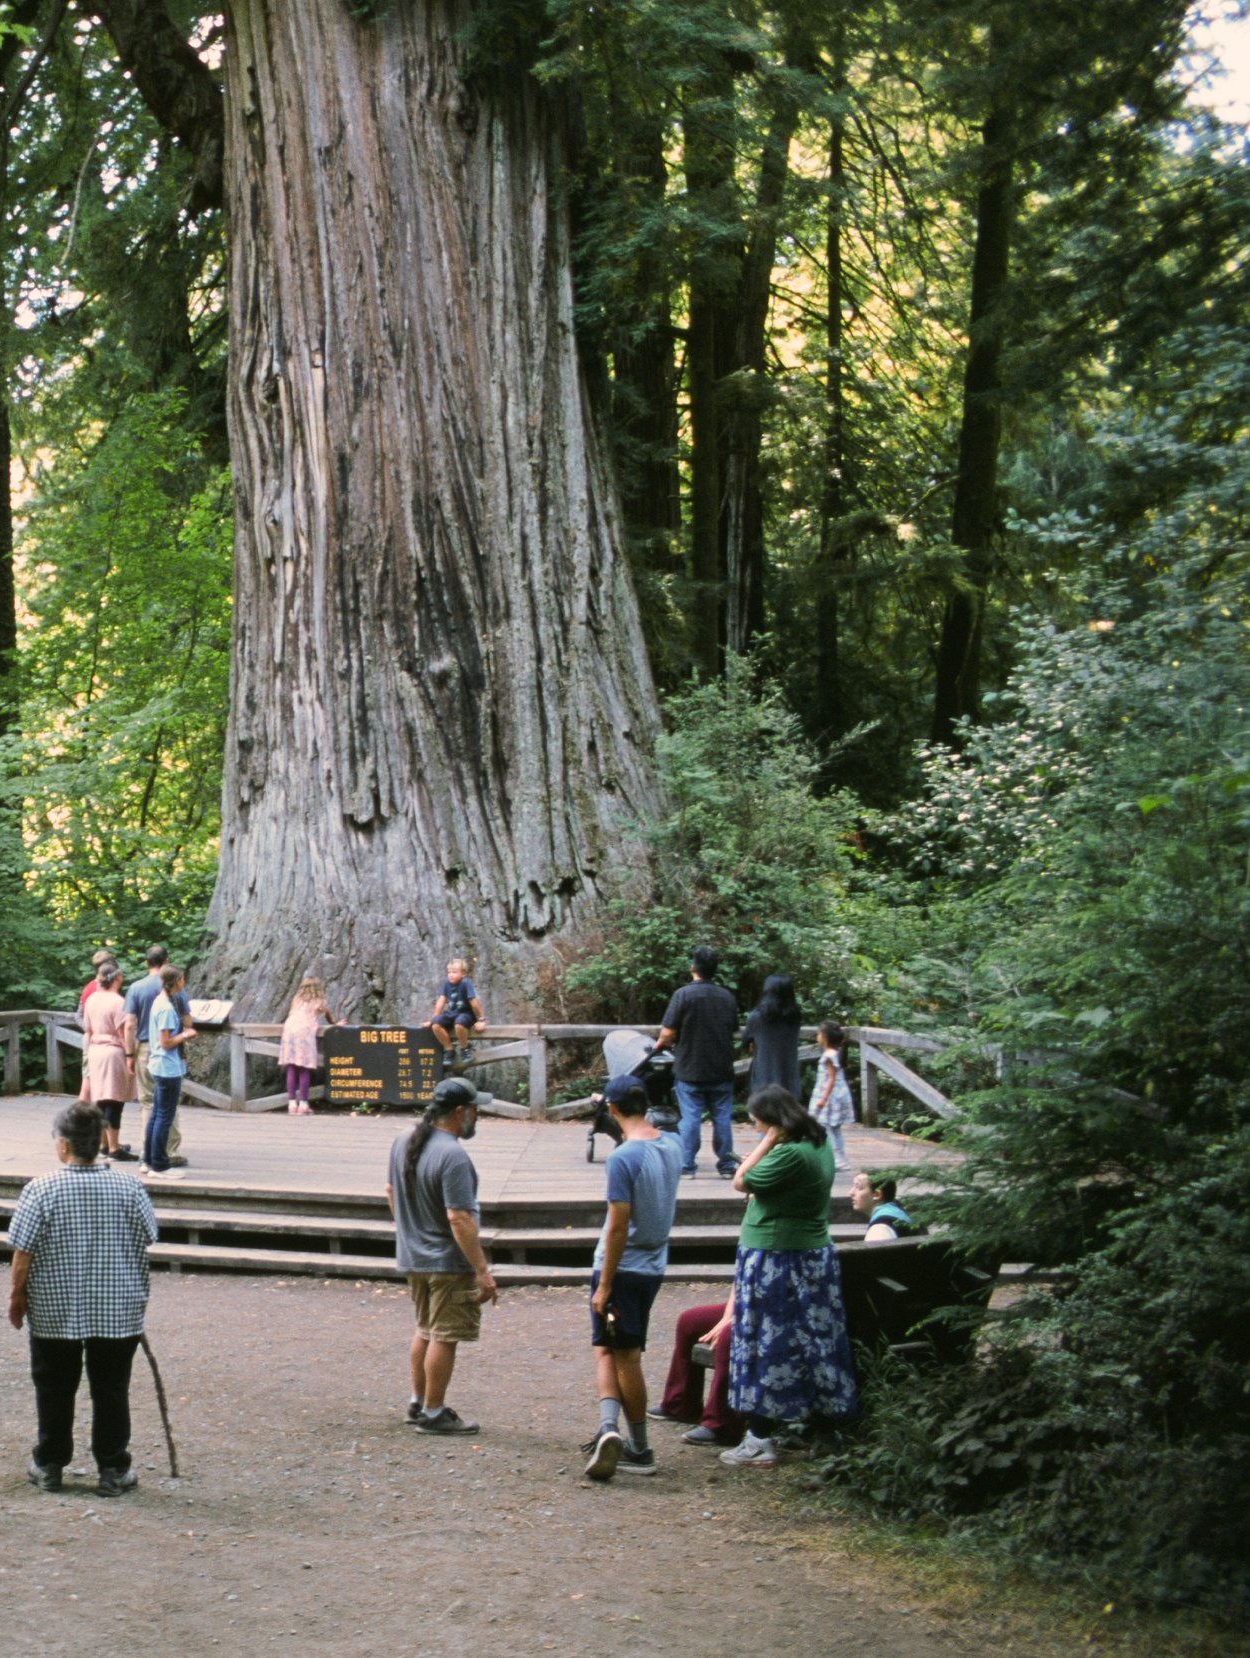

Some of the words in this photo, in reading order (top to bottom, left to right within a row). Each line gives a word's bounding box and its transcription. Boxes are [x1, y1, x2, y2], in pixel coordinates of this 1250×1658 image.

[360, 1030, 378, 1043] BIG
[380, 1030, 407, 1043] TREE
[329, 1056, 354, 1065] HEIGHT
[329, 1068, 363, 1076] DIAMETER
[330, 1079, 383, 1088] CIRCUMFERENCE
[330, 1090, 365, 1099] ESTIMATED
[366, 1091, 379, 1099] AGE
